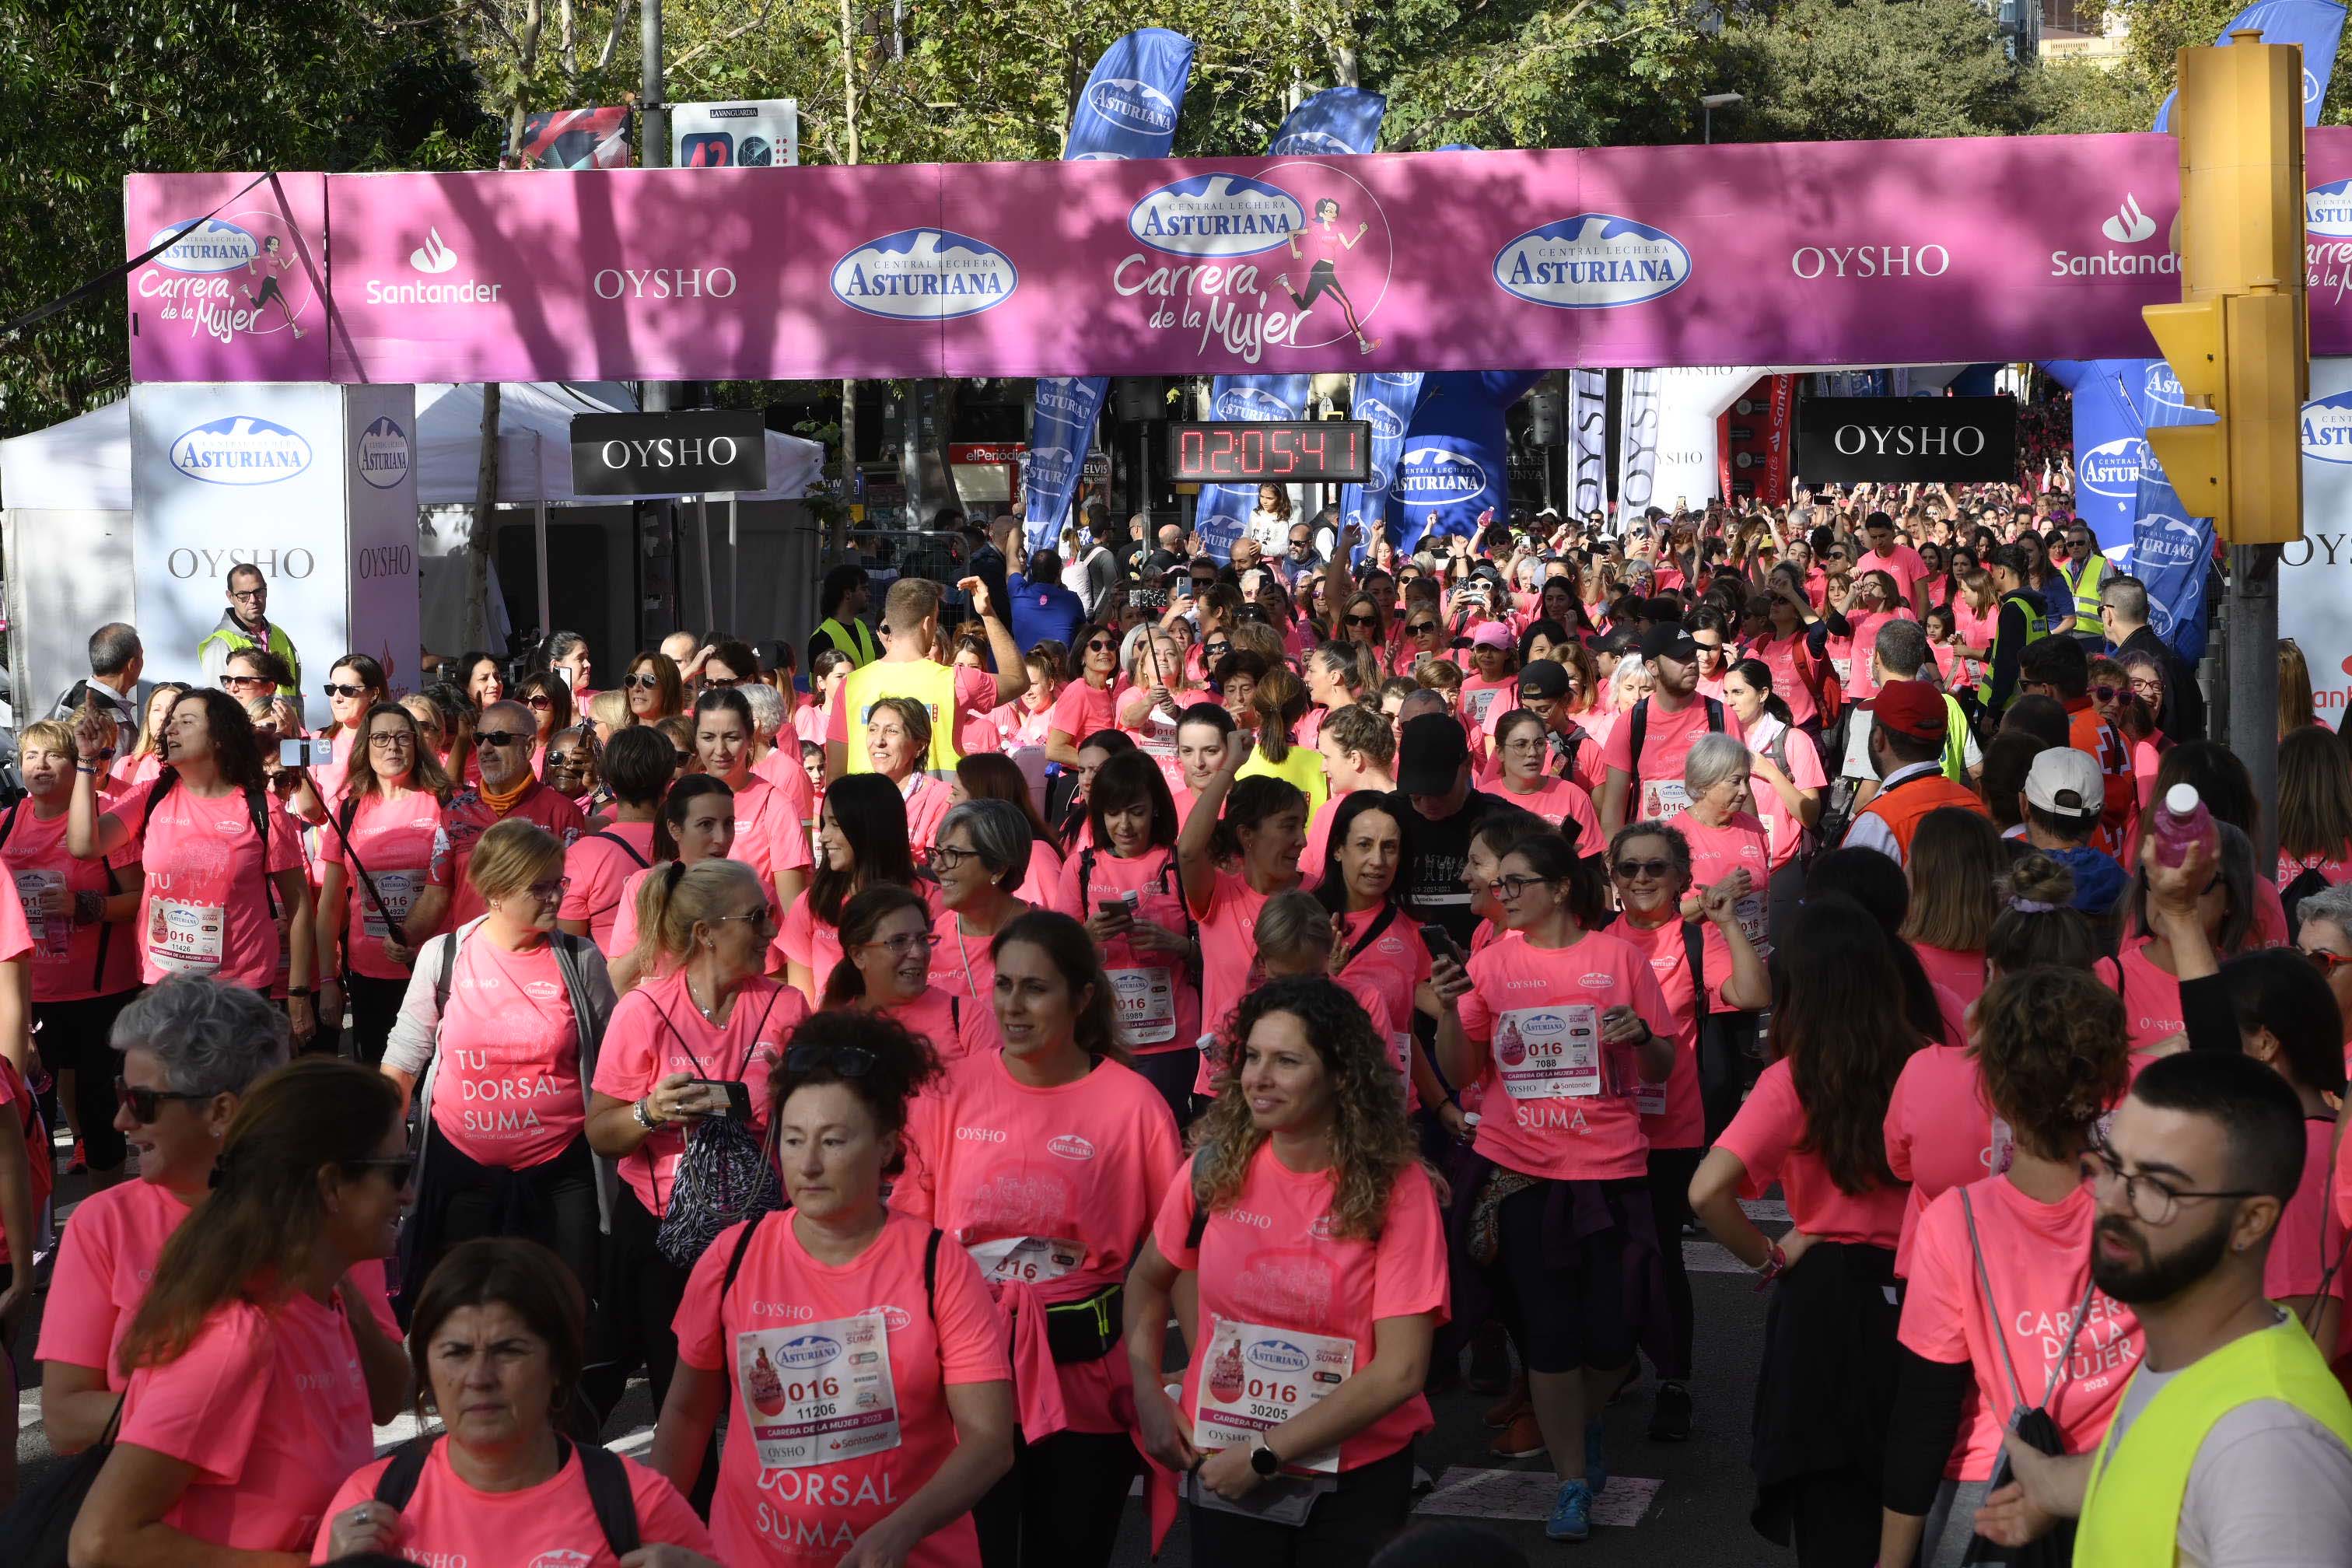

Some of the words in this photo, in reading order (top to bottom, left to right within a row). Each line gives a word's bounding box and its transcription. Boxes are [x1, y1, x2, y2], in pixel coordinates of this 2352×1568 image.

[1093, 87, 1171, 130] ASTURIANA
[1169, 202, 1224, 211] CENTRAL
[1230, 201, 1286, 210] LECHERA
[2306, 201, 2352, 223] ASTU
[1142, 205, 1293, 237] ASTURIANA
[157, 244, 250, 259] ASTURIANA
[1538, 247, 1601, 257] CENTRAL
[1606, 245, 1669, 255] LECHERA
[874, 261, 932, 270] CENTRAL
[938, 259, 996, 268] LECHERA
[1508, 250, 1676, 285] ASTURIANA
[1792, 244, 1950, 279] OYSHO
[138, 269, 229, 298] Carrera
[593, 268, 737, 299] OYSHO
[845, 263, 1003, 296] ASTURIANA
[1113, 253, 1258, 296] Carrera
[2324, 268, 2337, 286] la
[366, 279, 502, 304] Santander
[161, 299, 178, 320] de
[181, 299, 194, 320] la
[191, 296, 264, 343] Mujer
[1149, 299, 1175, 329] de
[1182, 298, 1202, 328] la
[1198, 291, 1314, 364] Mujer
[1221, 397, 1286, 421] ASTURIAN
[1835, 424, 1985, 455] OYSHO
[180, 442, 302, 467] ASTURIANA
[361, 443, 407, 471] ASTURIANA
[602, 436, 737, 469] OYSHO
[1181, 432, 1355, 473] 02:05:41
[1084, 464, 1108, 474] ELVIS
[1391, 473, 1479, 492] ASTURIANA
[167, 548, 314, 579] OYSHO
[359, 544, 411, 579] OYSHO
[1664, 803, 1685, 812] 016
[149, 872, 170, 890] TU
[382, 896, 408, 906] 016
[169, 914, 197, 926] ASTURIANA
[1741, 919, 1759, 931] 016
[170, 930, 194, 943] 016
[172, 943, 191, 953] 11426
[1507, 979, 1547, 989] OYSHO
[1118, 998, 1146, 1010] 016
[1525, 1023, 1563, 1032] ASTURIANA
[1528, 1042, 1563, 1056] 016
[455, 1050, 486, 1070] TU
[1535, 1059, 1557, 1069] 7088
[461, 1075, 561, 1101] DORSAL
[1507, 1085, 1537, 1094] OYSHO
[1561, 1081, 1592, 1090] Santander
[464, 1108, 541, 1132] SUMA
[1517, 1106, 1587, 1129] SUMA
[956, 1127, 1006, 1143] OYSHO
[1051, 1142, 1093, 1157] ASTURIANA
[996, 1257, 1038, 1279] 016
[752, 1300, 814, 1321] OYSHO
[847, 1334, 876, 1345] SUMA
[2044, 1335, 2082, 1360] DE
[2092, 1322, 2126, 1352] LA
[782, 1346, 837, 1364] ASTURIANA
[1249, 1347, 1304, 1368] ASTURIANA
[1315, 1354, 1343, 1364] SUMA
[2044, 1338, 2137, 1389] MUJER
[789, 1377, 840, 1402] 016
[1248, 1379, 1297, 1404] 016
[2084, 1376, 2109, 1392] 2023
[797, 1403, 837, 1420] 11206
[1213, 1413, 1251, 1428] CARRERA
[1252, 1420, 1264, 1430] DE
[1250, 1404, 1289, 1421] 30205
[767, 1426, 802, 1437] CARRERA
[803, 1425, 813, 1433] DE
[817, 1423, 828, 1432] LA
[829, 1419, 859, 1430] MUJER
[863, 1414, 883, 1424] 2023
[842, 1431, 889, 1449] Santander
[1209, 1430, 1251, 1442] OYSHO
[768, 1445, 806, 1458] OYSHO
[757, 1468, 898, 1507] DORSAL
[757, 1503, 857, 1549] SUMA
